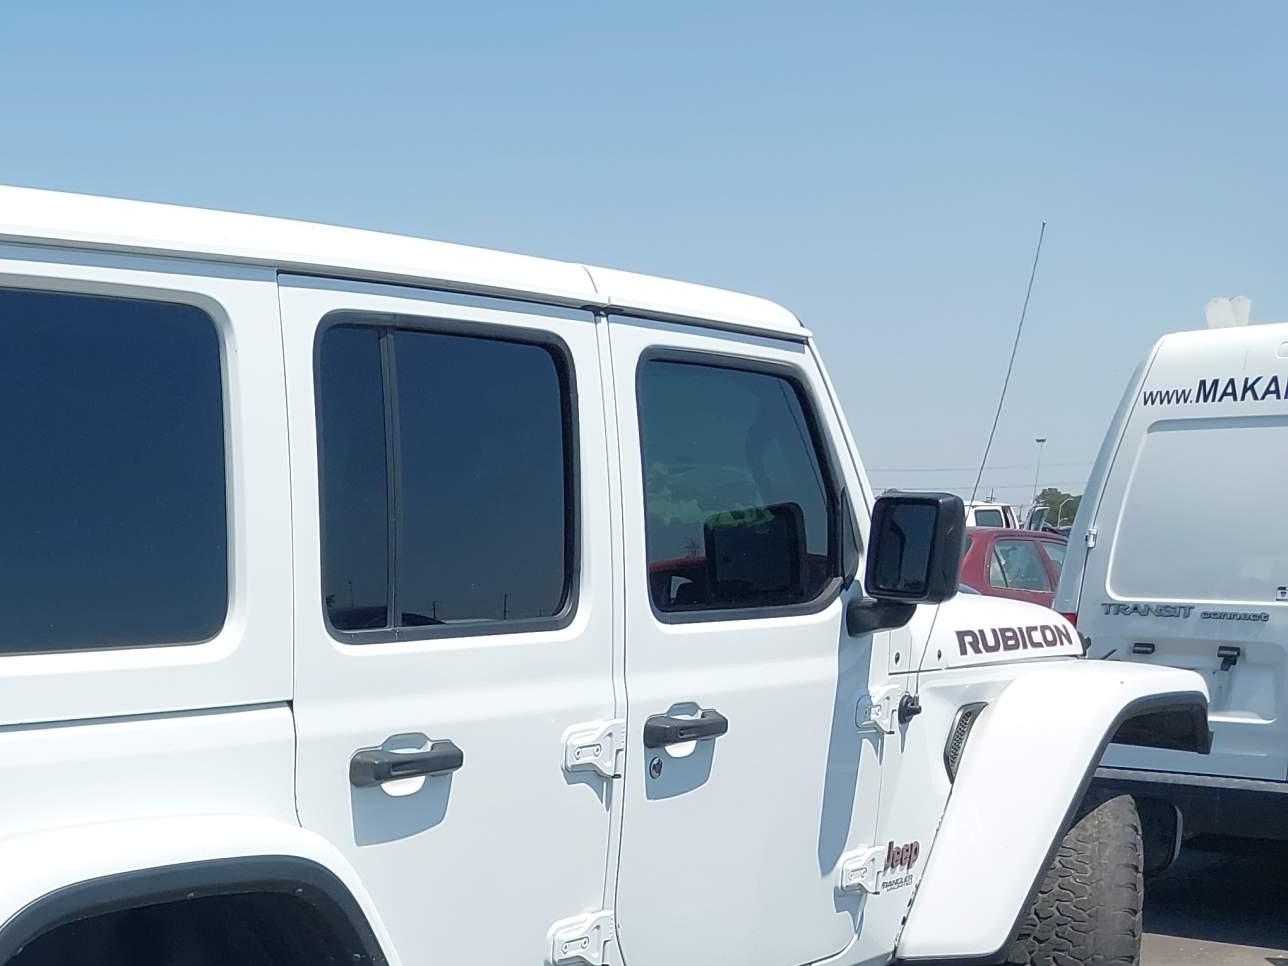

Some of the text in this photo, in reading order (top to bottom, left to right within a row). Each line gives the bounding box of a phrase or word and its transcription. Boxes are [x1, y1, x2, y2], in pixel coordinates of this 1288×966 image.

[1143, 375, 1288, 406] www.MAKA
[1100, 603, 1196, 618] TRANSIT
[955, 624, 1073, 656] RUBICON
[883, 840, 920, 871] Jeep
